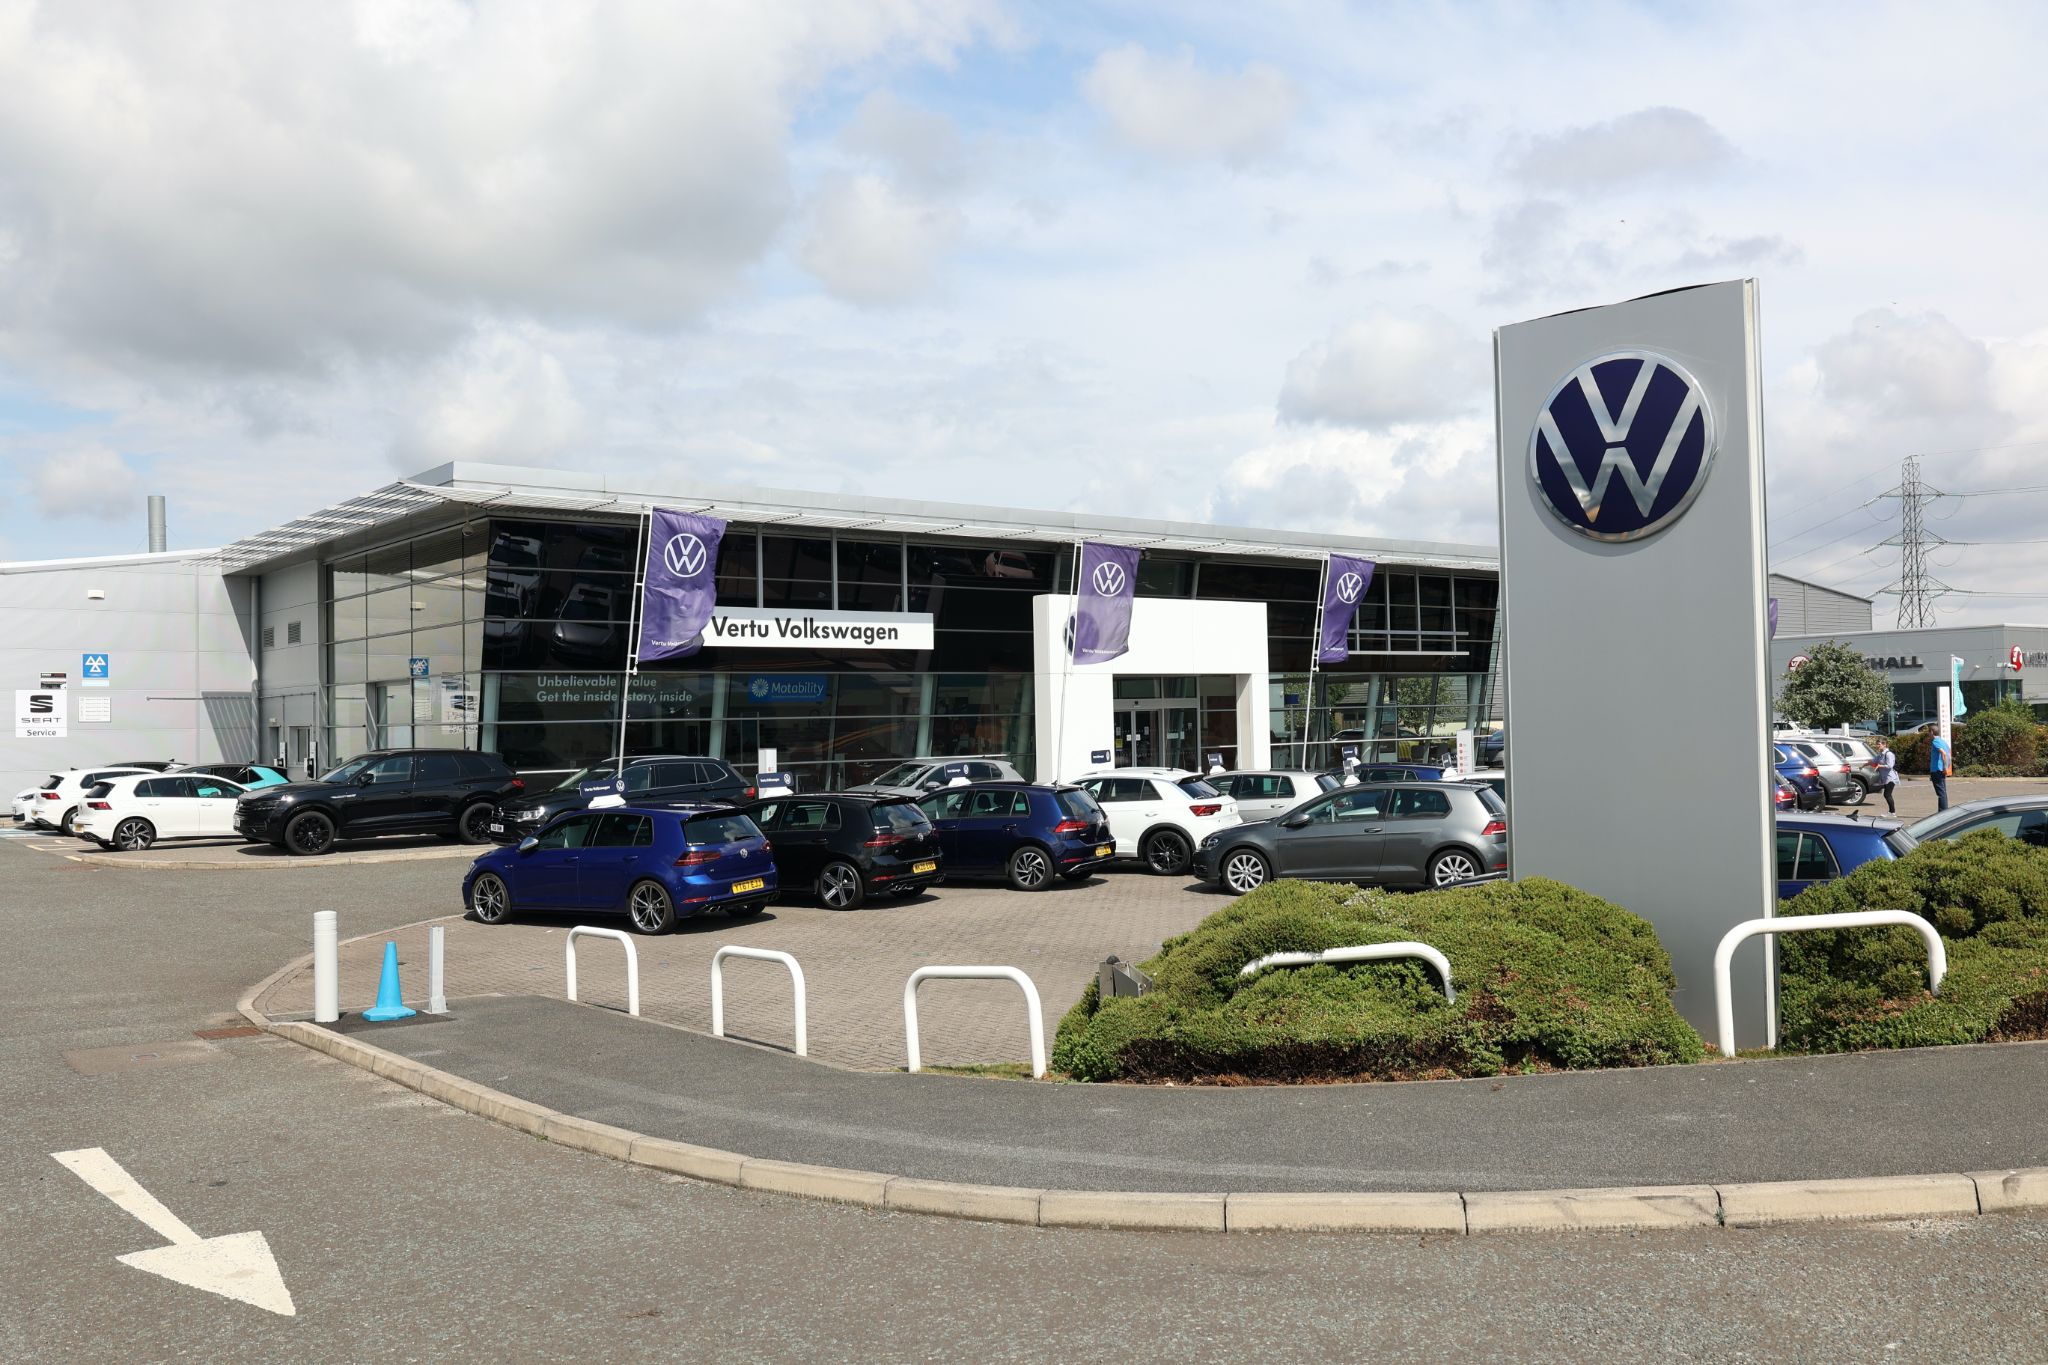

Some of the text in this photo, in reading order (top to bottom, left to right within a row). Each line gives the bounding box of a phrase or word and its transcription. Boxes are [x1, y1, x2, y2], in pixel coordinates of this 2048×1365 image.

[711, 616, 899, 645] Vertu Volkswagen
[1866, 656, 1923, 669] HALL
[537, 675, 657, 687] Unbelievable value
[771, 681, 824, 697] Motability
[536, 690, 693, 704] Get the inside story, inside
[26, 729, 57, 737] Service
